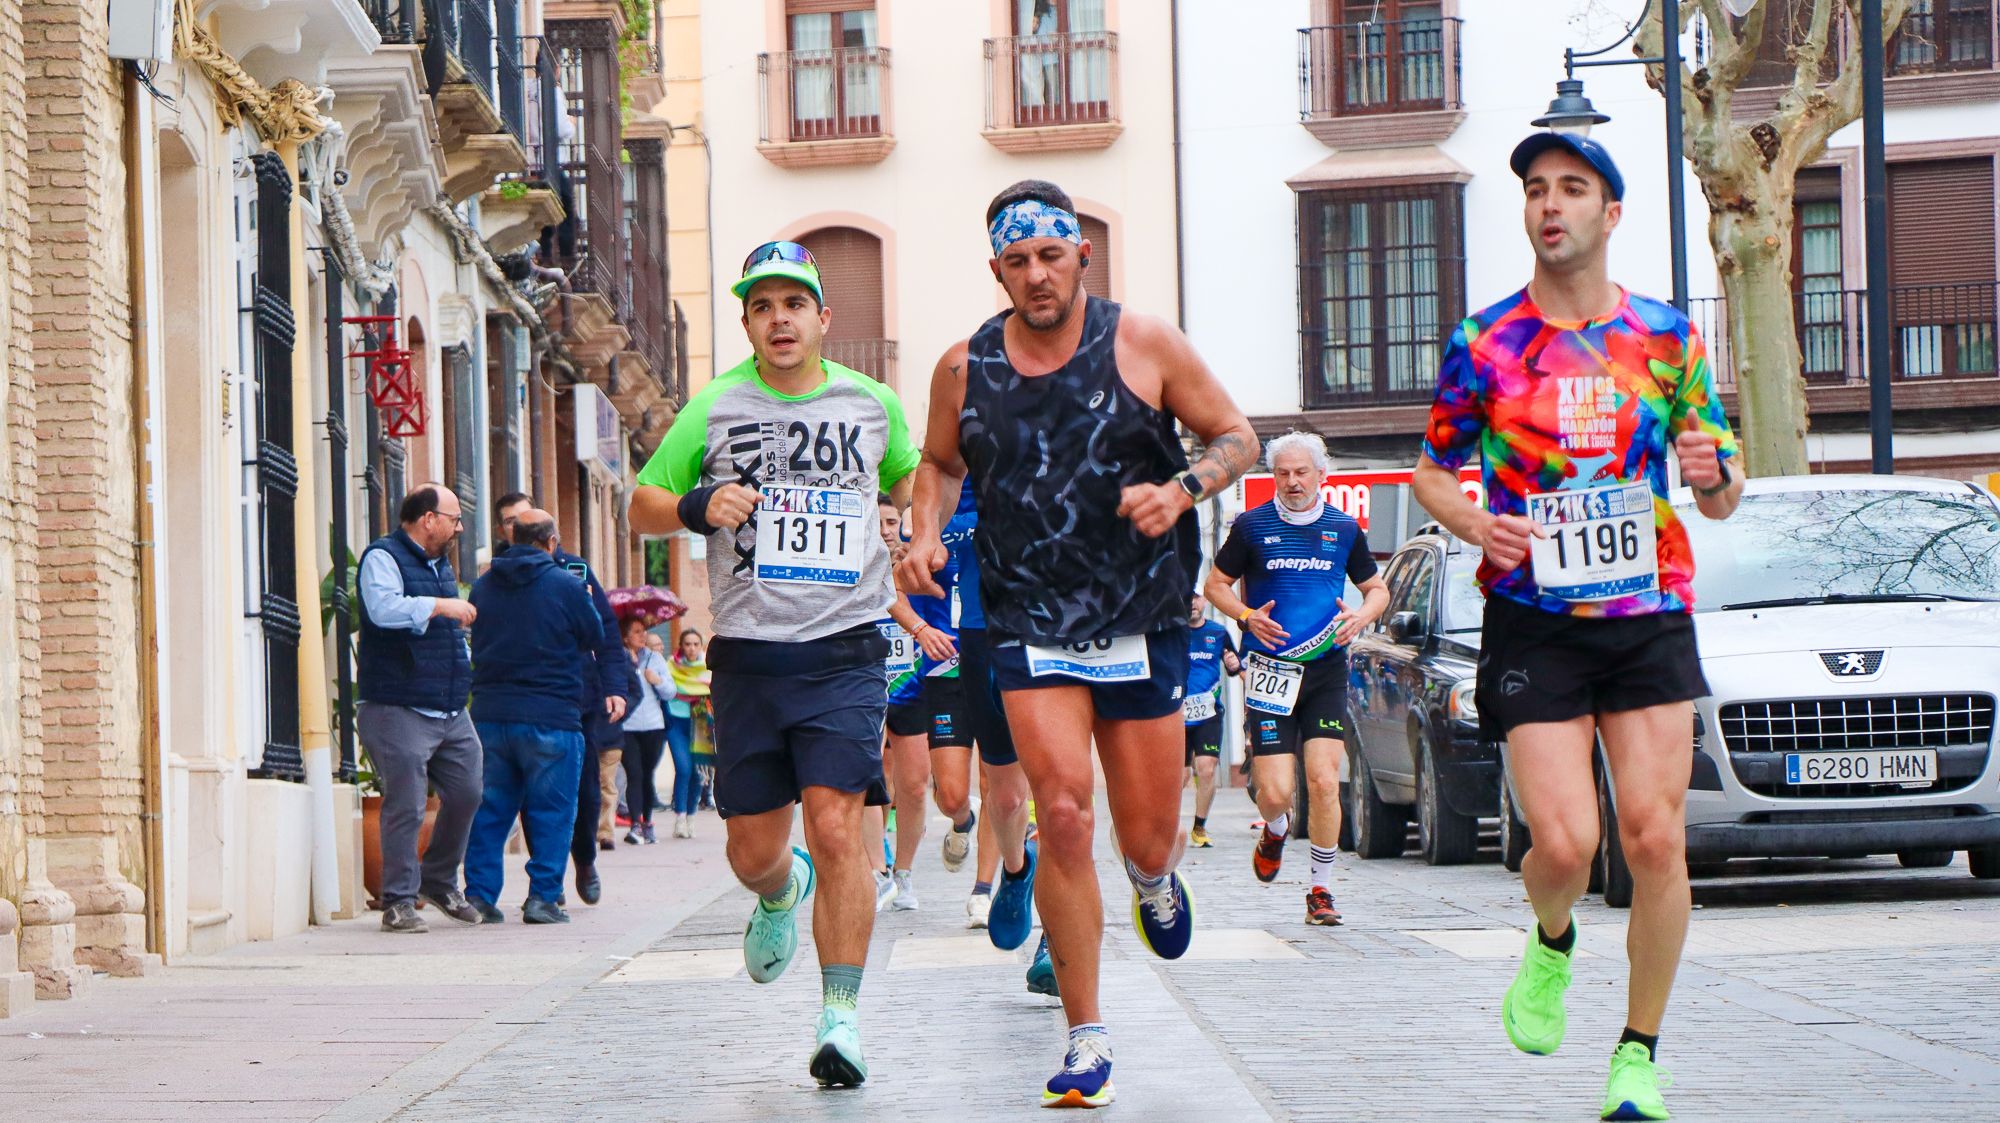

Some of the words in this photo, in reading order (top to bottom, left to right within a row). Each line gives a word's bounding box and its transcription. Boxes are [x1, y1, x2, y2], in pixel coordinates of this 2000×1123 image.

[1557, 376, 1594, 404] XII
[1596, 376, 1616, 394] 08
[1559, 404, 1597, 419] MEDIA
[1596, 403, 1617, 414] 2026
[774, 421, 786, 437] Sol
[1559, 415, 1617, 434] MARATÓN
[788, 420, 865, 473] 26K
[1567, 434, 1591, 449] 10K
[1591, 439, 1616, 448] LUCENA
[774, 489, 808, 513] 21K
[1321, 484, 1371, 519] ODA
[1546, 494, 1588, 524] 21K
[773, 516, 846, 556] 1311
[1550, 519, 1639, 569] 1196
[1266, 557, 1333, 571] enerplus
[1249, 670, 1289, 698] 1204
[1186, 704, 1208, 720] 232
[1806, 756, 1869, 780] 6280
[1880, 755, 1927, 778] HMN
